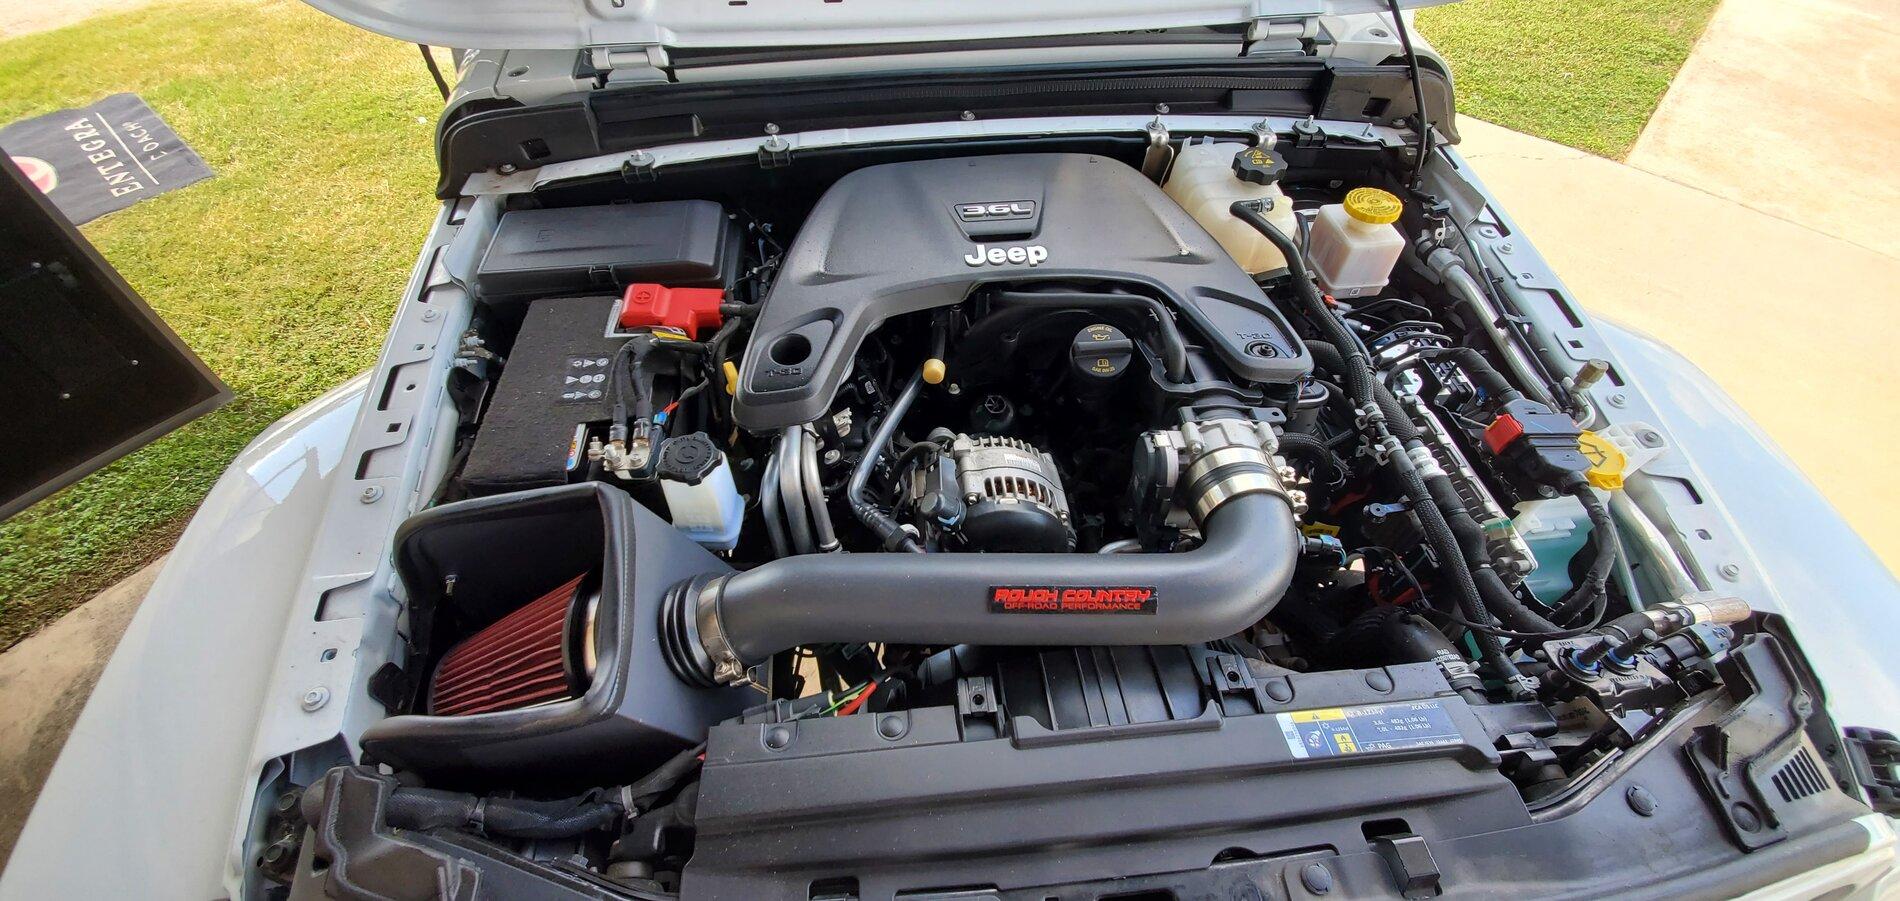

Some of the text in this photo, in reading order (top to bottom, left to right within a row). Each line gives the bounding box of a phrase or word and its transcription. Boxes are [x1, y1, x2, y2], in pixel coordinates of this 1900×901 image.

[65, 117, 144, 198] ENTEGRA
[962, 203, 1031, 218] 3.6L
[964, 244, 1048, 267] Jeep
[994, 588, 1151, 603] ROUGH COUNTRY
[1004, 602, 1141, 611] OFF-ROAD PERFORMANCE
